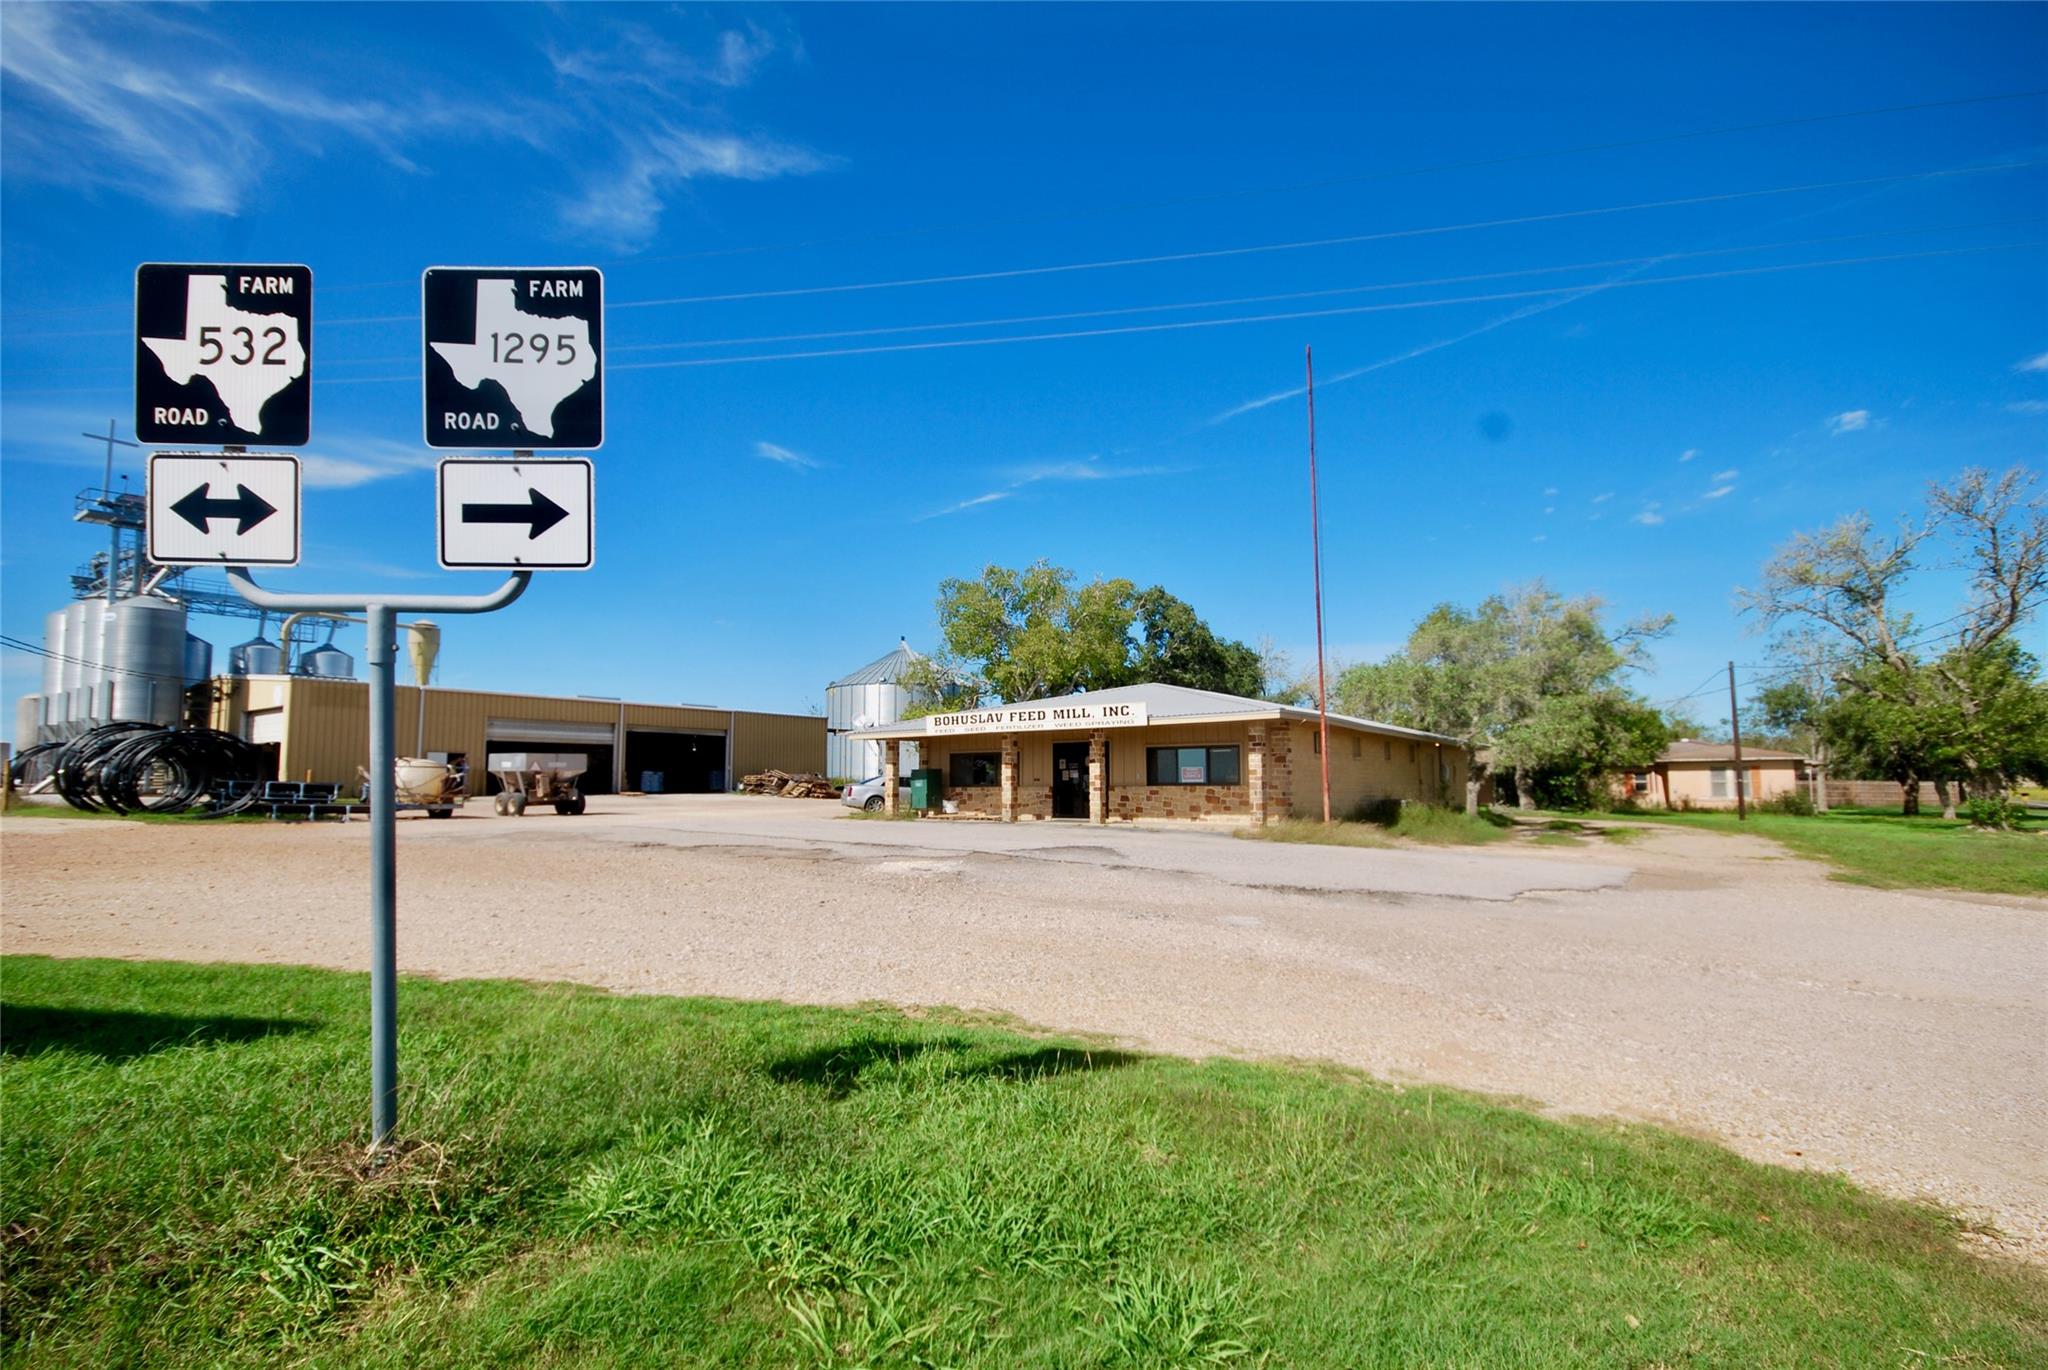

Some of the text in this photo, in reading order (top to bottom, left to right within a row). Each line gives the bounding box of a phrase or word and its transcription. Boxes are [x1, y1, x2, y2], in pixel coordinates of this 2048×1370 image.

[239, 276, 294, 295] FARM
[528, 280, 584, 298] FARM
[198, 326, 287, 366] 532
[490, 332, 577, 365] 1295
[154, 407, 209, 425] ROAD
[444, 412, 500, 431] ROAD
[934, 712, 1003, 726] BOHUSLAV
[1009, 710, 1046, 722] FEED
[1103, 705, 1135, 717] INC.
[1085, 718, 1135, 727] SPRAYING
